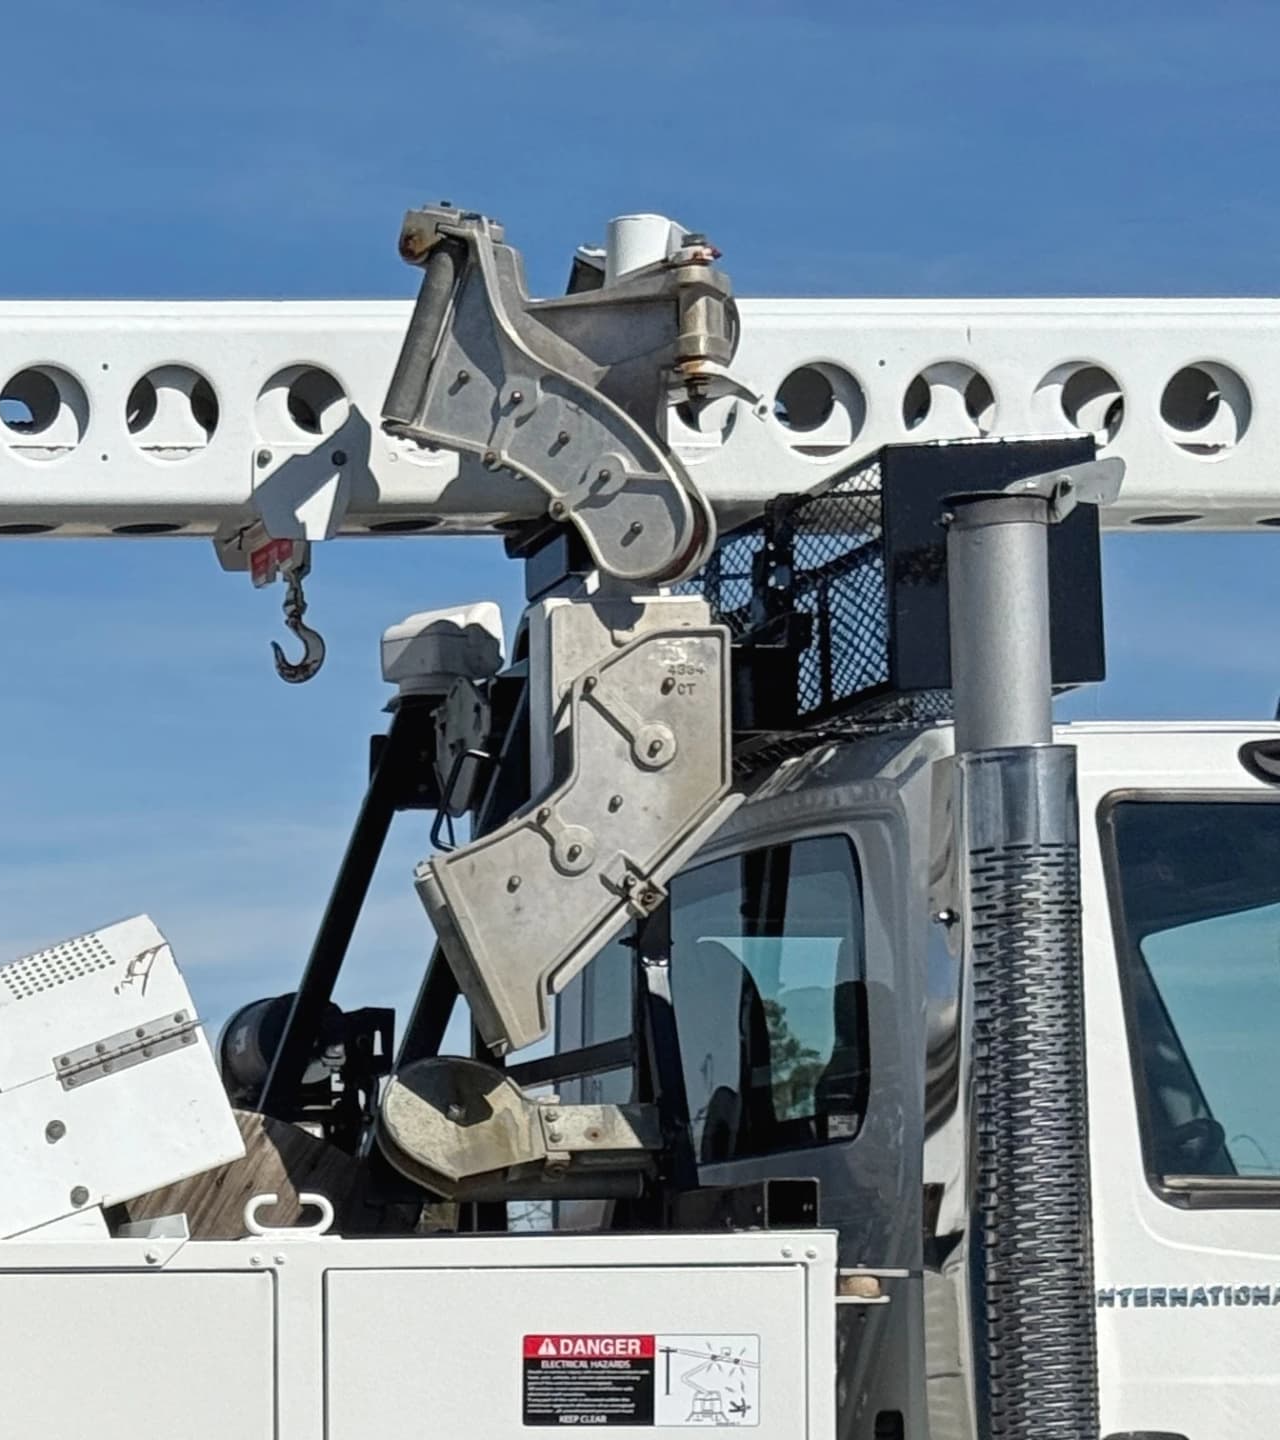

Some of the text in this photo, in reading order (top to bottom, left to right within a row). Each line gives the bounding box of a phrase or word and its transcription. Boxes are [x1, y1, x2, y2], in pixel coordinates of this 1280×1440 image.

[1096, 1285, 1280, 1308] NTERNATION
[559, 1338, 642, 1356] DANGER
[541, 1359, 631, 1370] ELECTRICAL HAZARDS
[559, 1414, 607, 1424] KEEP CLEAR
